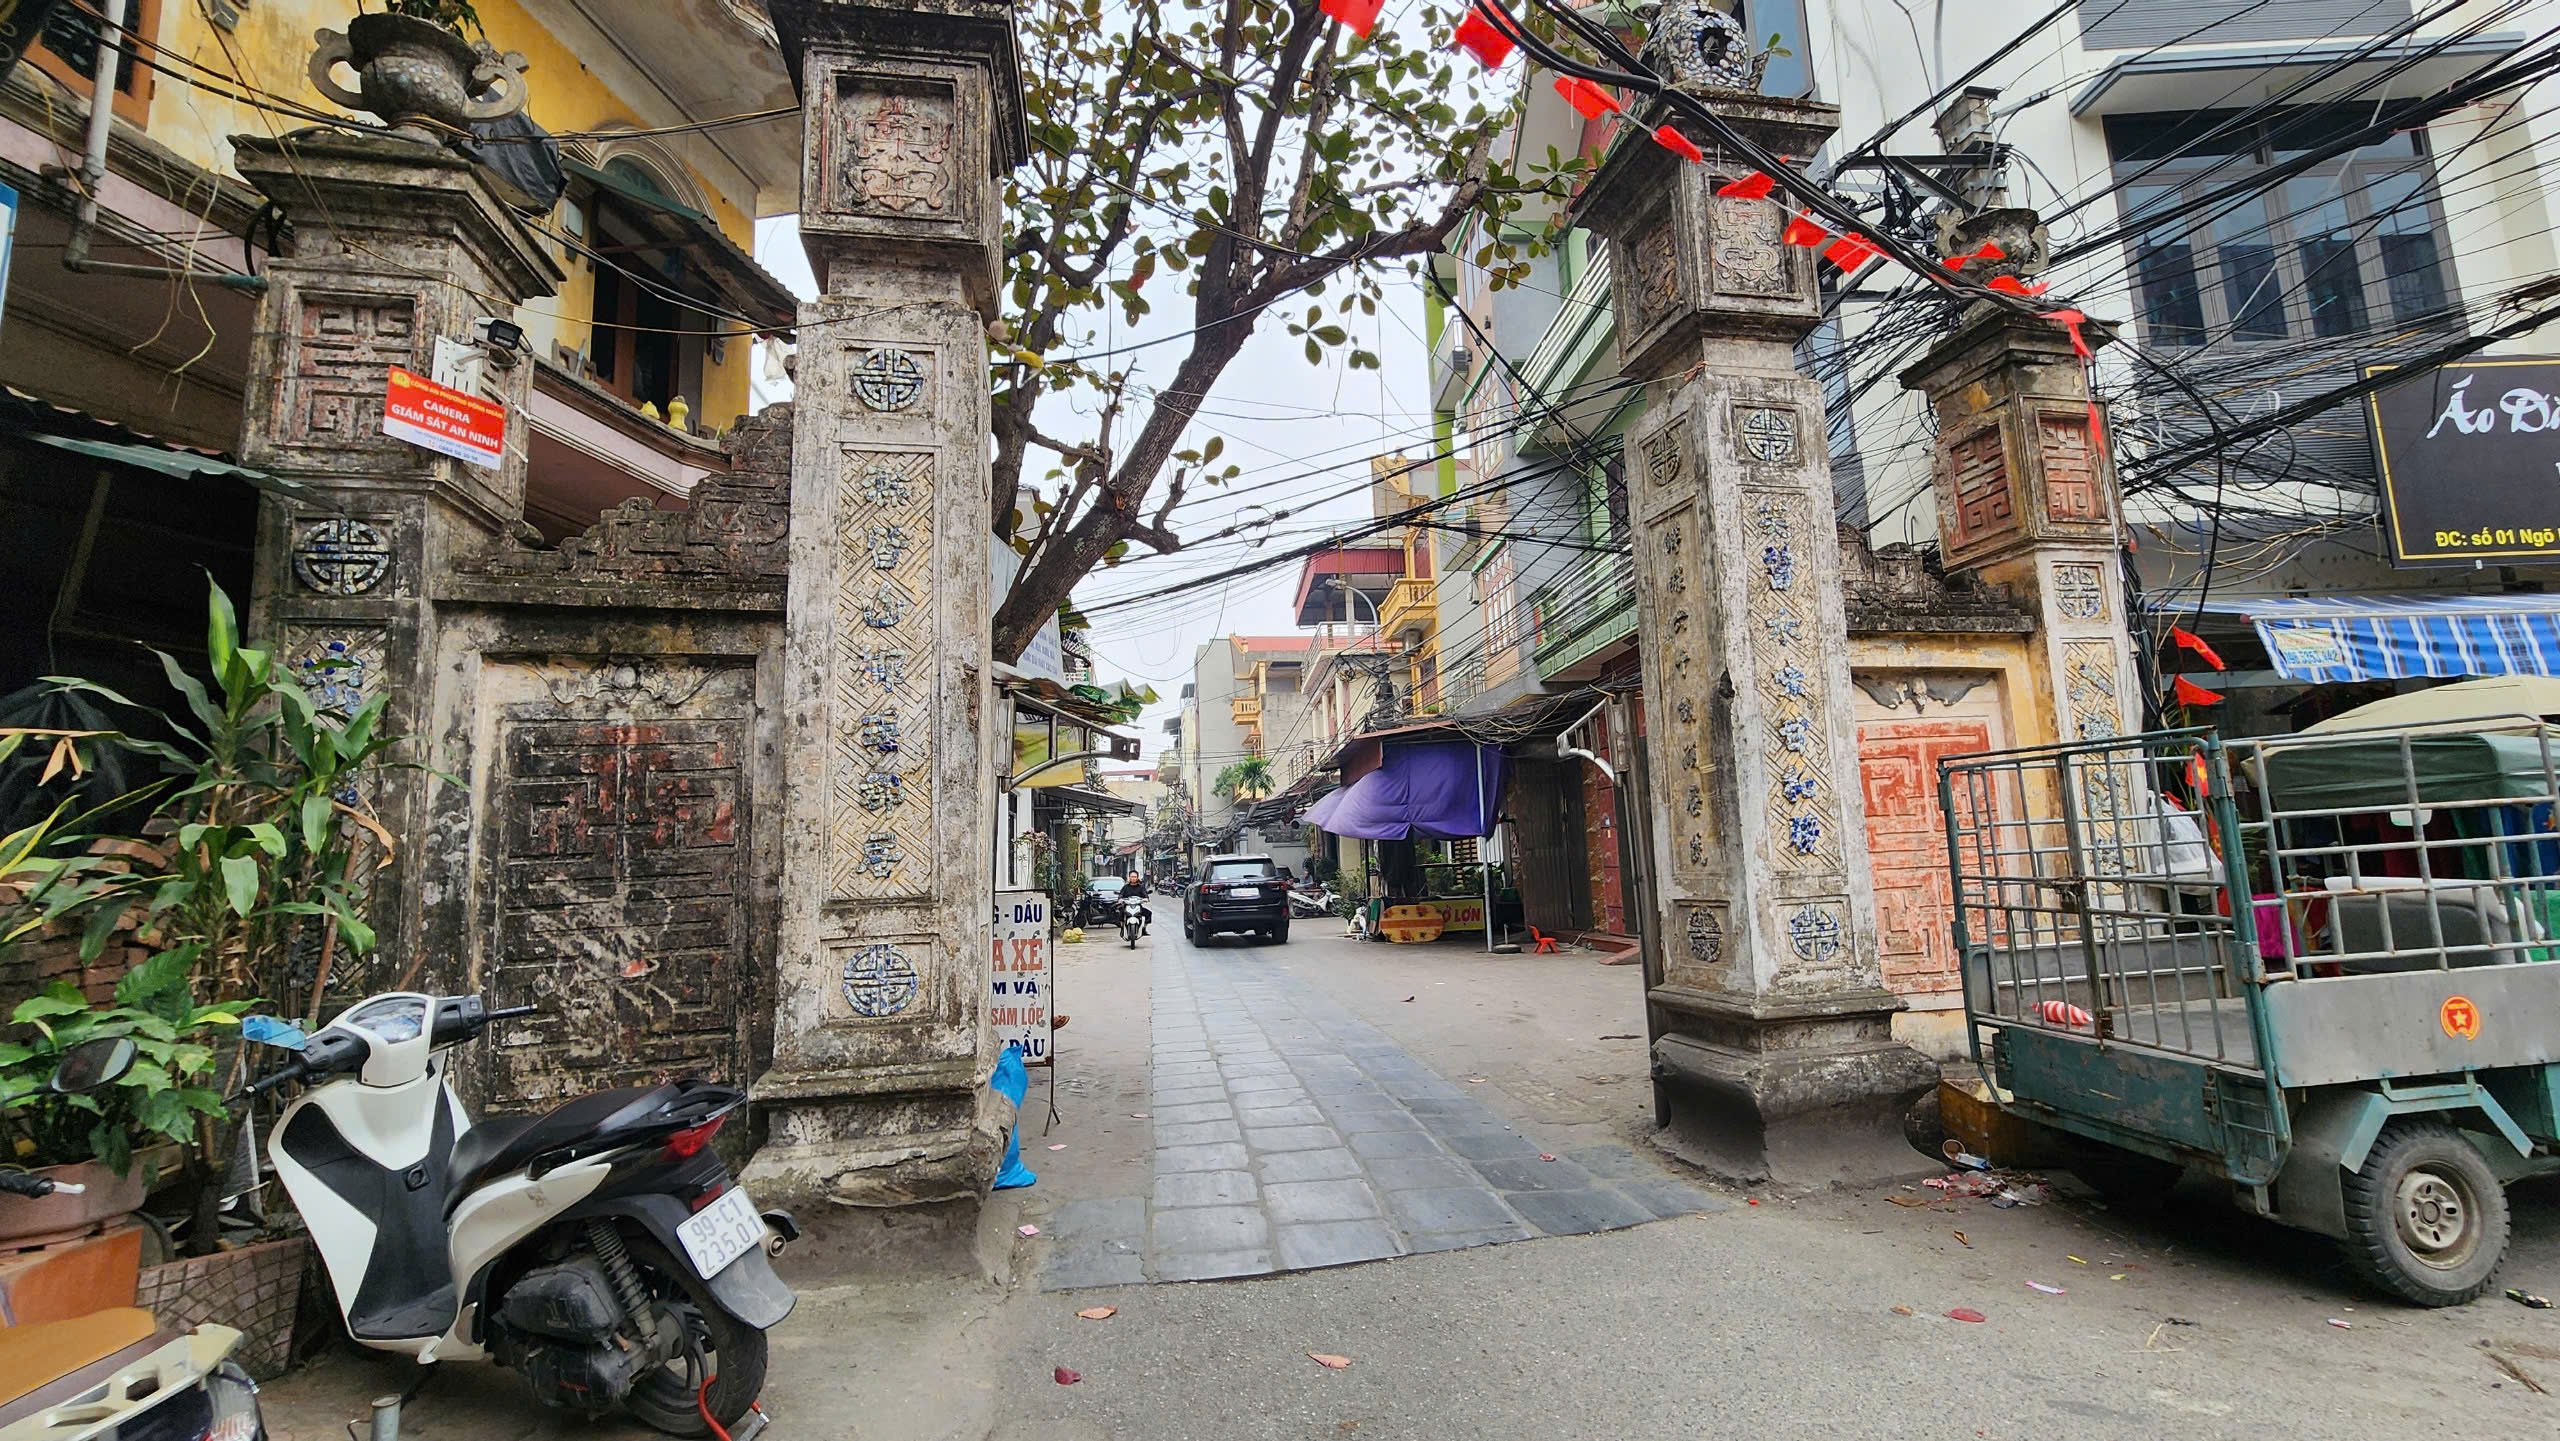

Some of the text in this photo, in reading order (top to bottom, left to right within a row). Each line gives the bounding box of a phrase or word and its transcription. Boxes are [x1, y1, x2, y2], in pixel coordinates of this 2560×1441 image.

[423, 399, 471, 424] CAMERA
[2426, 374, 2495, 439] Áo
[391, 403, 424, 423] GIÁM
[426, 415, 448, 431] SÁT
[449, 425, 467, 438] AN
[468, 430, 499, 449] NINH
[2435, 530, 2467, 547] ĐC:
[2471, 526, 2493, 545] số
[2495, 529, 2515, 545] 01
[2519, 528, 2555, 547] Ngõ
[1014, 897, 1043, 923] DẦU
[1011, 938, 1043, 972] XE
[1013, 977, 1038, 995] VÁ
[991, 1003, 1018, 1026] SĂM
[697, 1215, 762, 1273] 235.01
